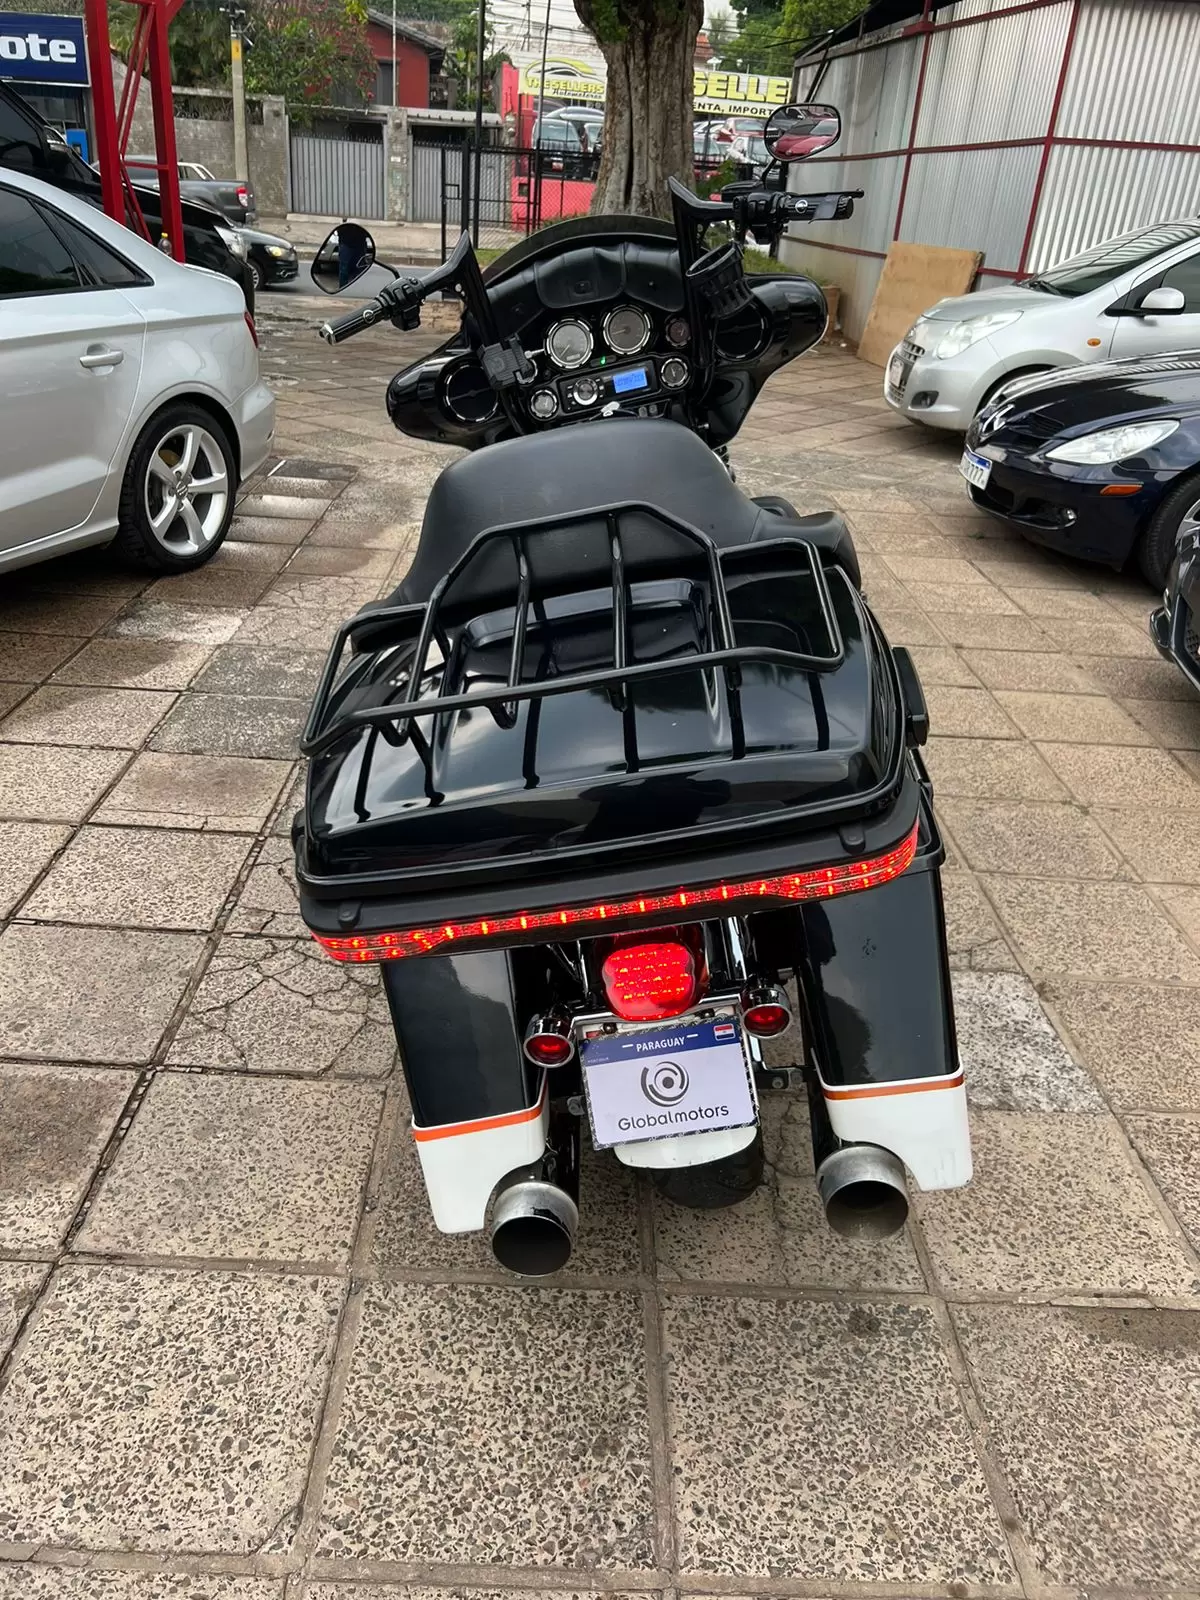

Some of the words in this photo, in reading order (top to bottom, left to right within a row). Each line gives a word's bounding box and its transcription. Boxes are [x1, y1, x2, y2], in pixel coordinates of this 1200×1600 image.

[0, 33, 76, 63] ote
[693, 71, 791, 104] SELLE
[636, 1037, 685, 1052] PARAGUAY
[618, 1105, 729, 1131] Globalmotors
